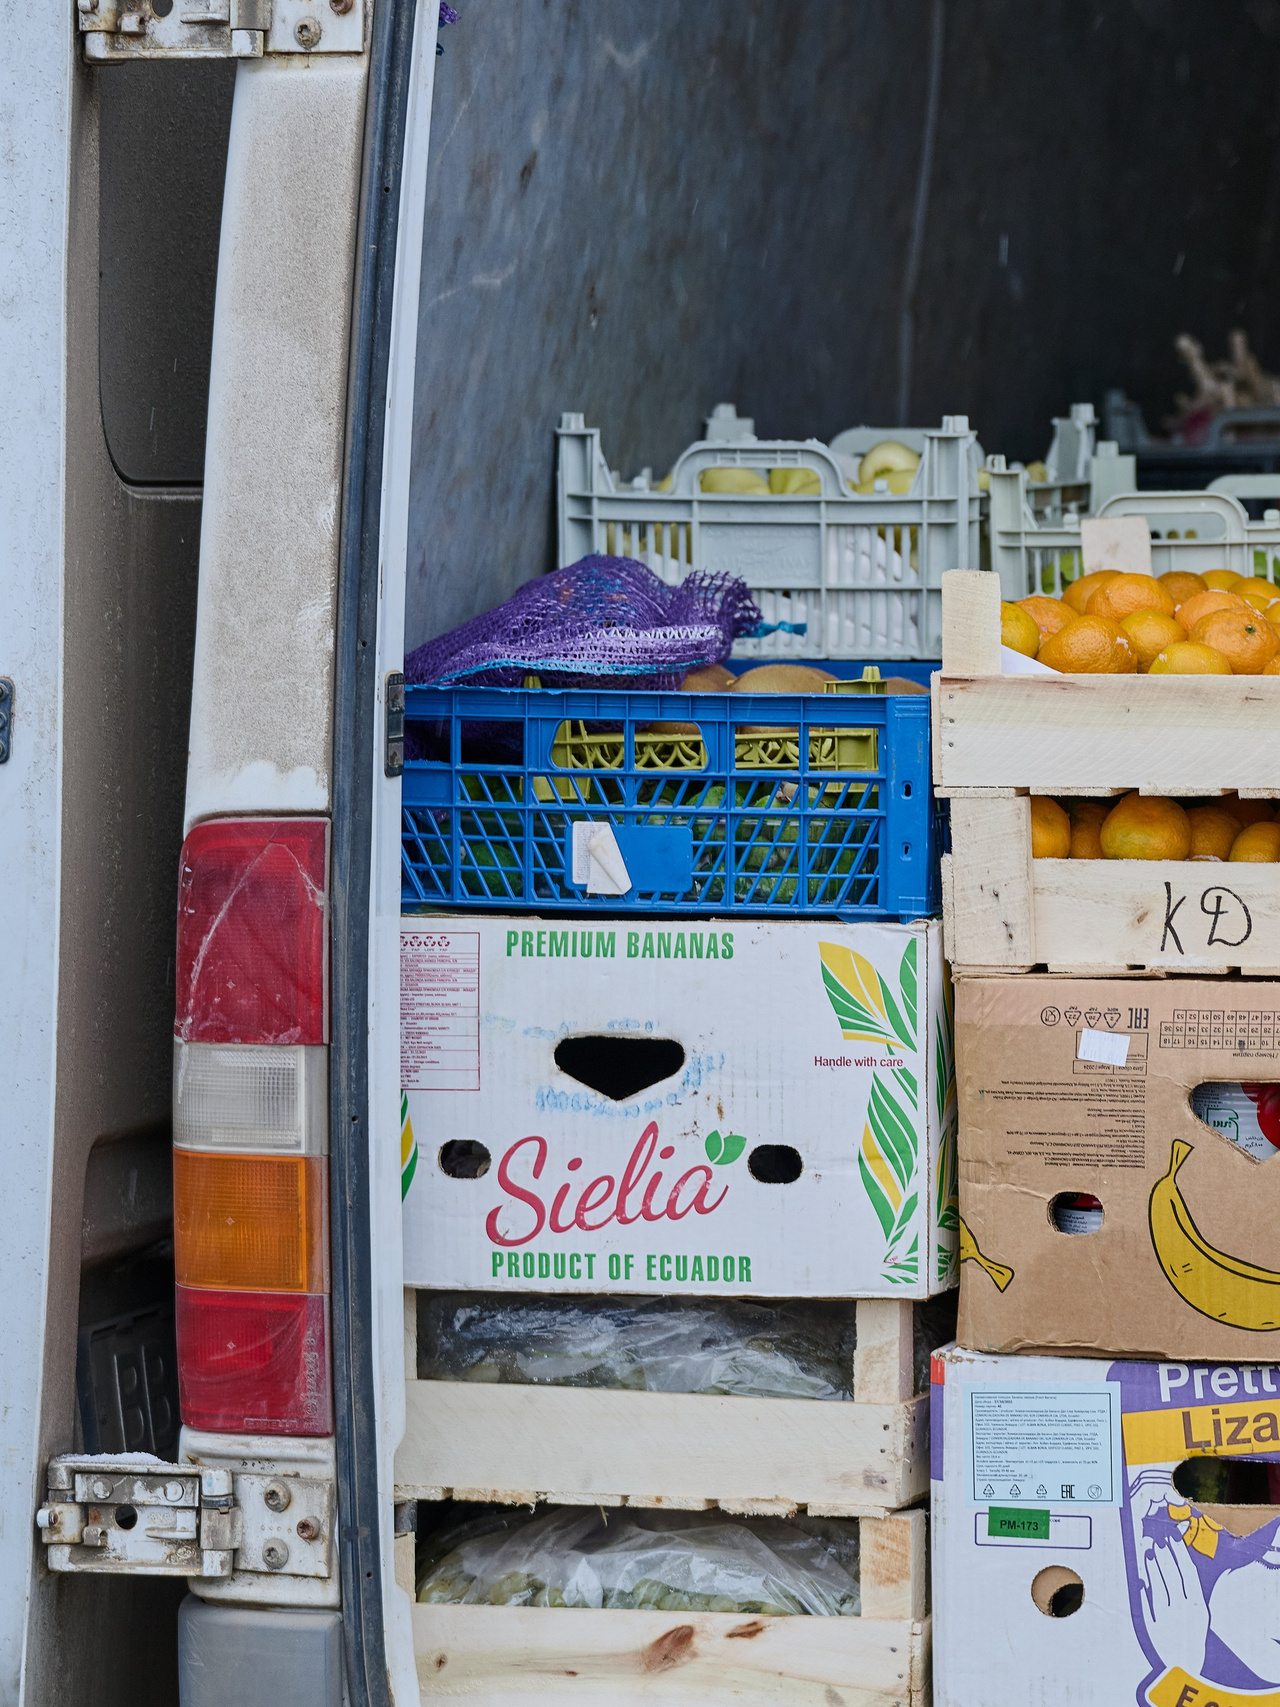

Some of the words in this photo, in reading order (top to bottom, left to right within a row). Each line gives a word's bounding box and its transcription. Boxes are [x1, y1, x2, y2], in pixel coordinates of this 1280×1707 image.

[506, 930, 616, 959] PREMIUM
[626, 930, 734, 960] BANANAS
[1127, 1008, 1149, 1029] EAC
[814, 1056, 852, 1067] Handle
[854, 1056, 877, 1067] with
[880, 1058, 904, 1067] care
[485, 1119, 729, 1247] Sielia
[491, 1251, 596, 1280] PRODUCT
[607, 1252, 636, 1280] OF
[646, 1254, 752, 1283] ECUADOR
[1182, 1408, 1280, 1450] Liza
[1061, 1484, 1075, 1498] EAC
[1000, 1520, 1038, 1531] PM-173
